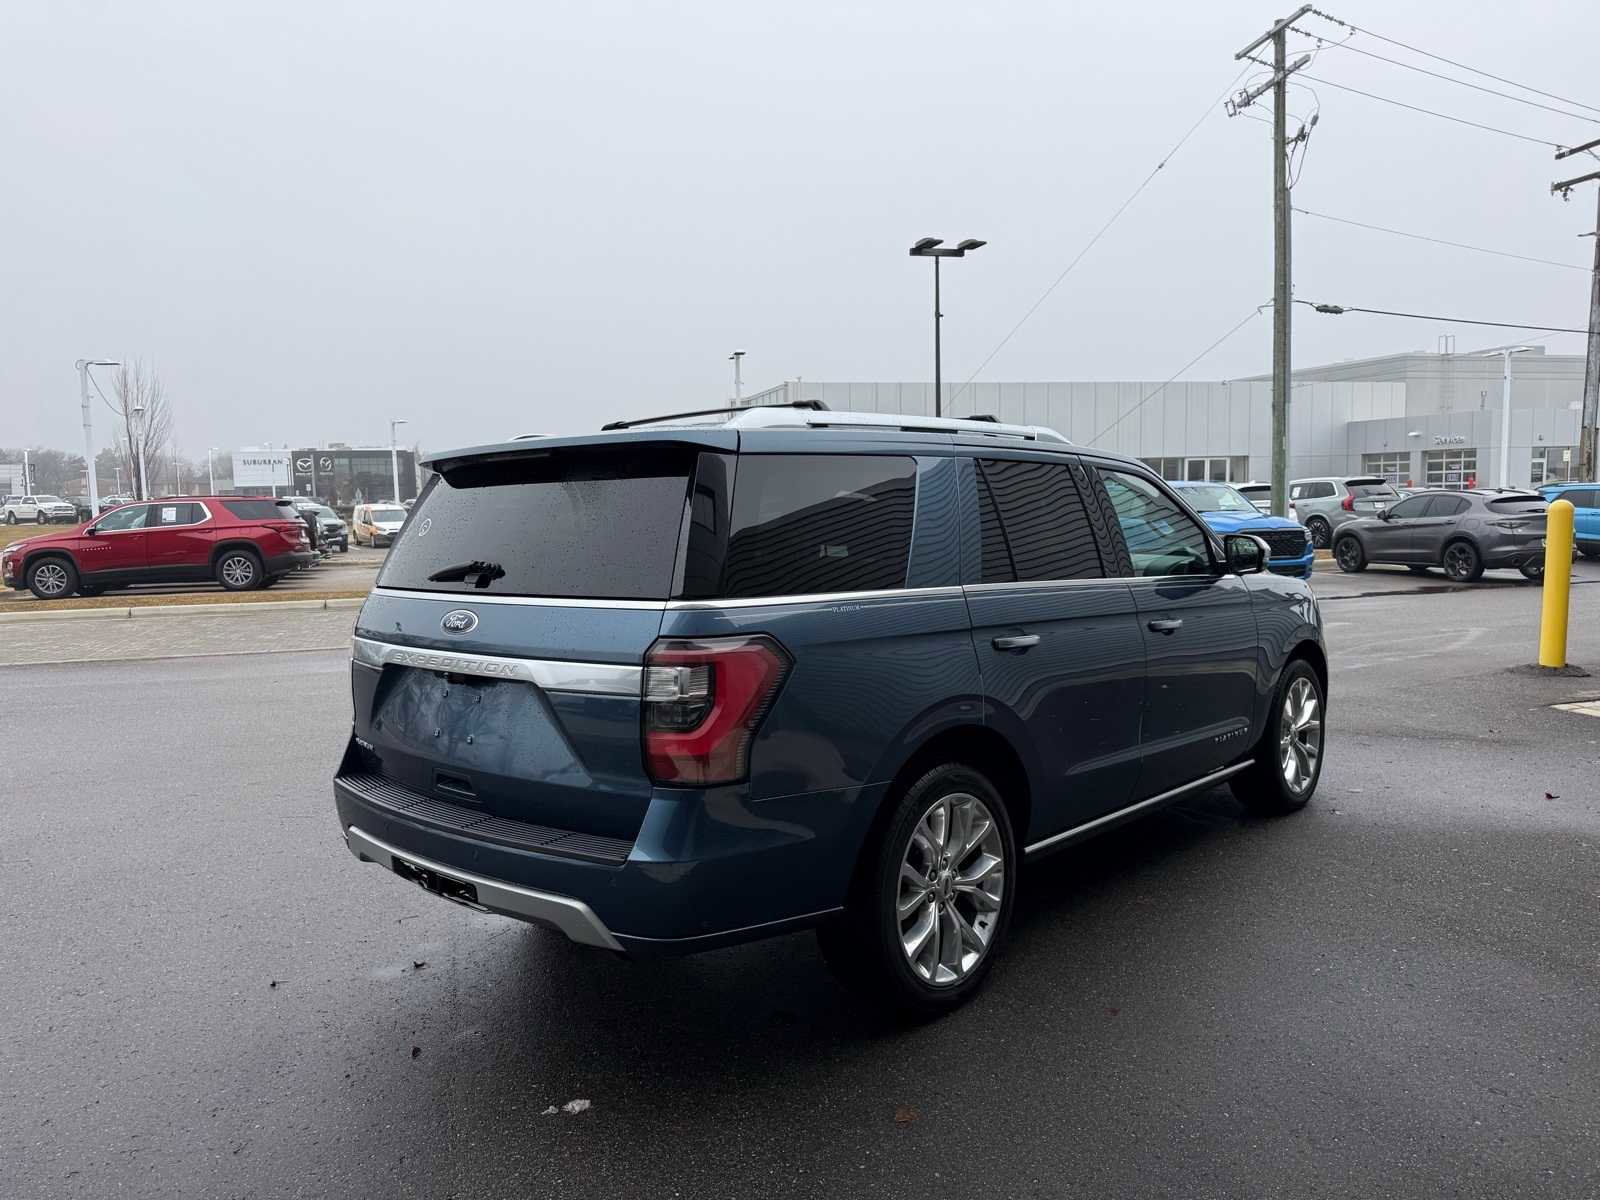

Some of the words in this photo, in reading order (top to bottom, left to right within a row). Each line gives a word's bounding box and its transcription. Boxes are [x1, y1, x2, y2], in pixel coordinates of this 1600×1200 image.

[242, 458, 284, 467] SUBURBAN
[445, 614, 469, 630] Ford
[393, 652, 519, 677] EXPEDITION
